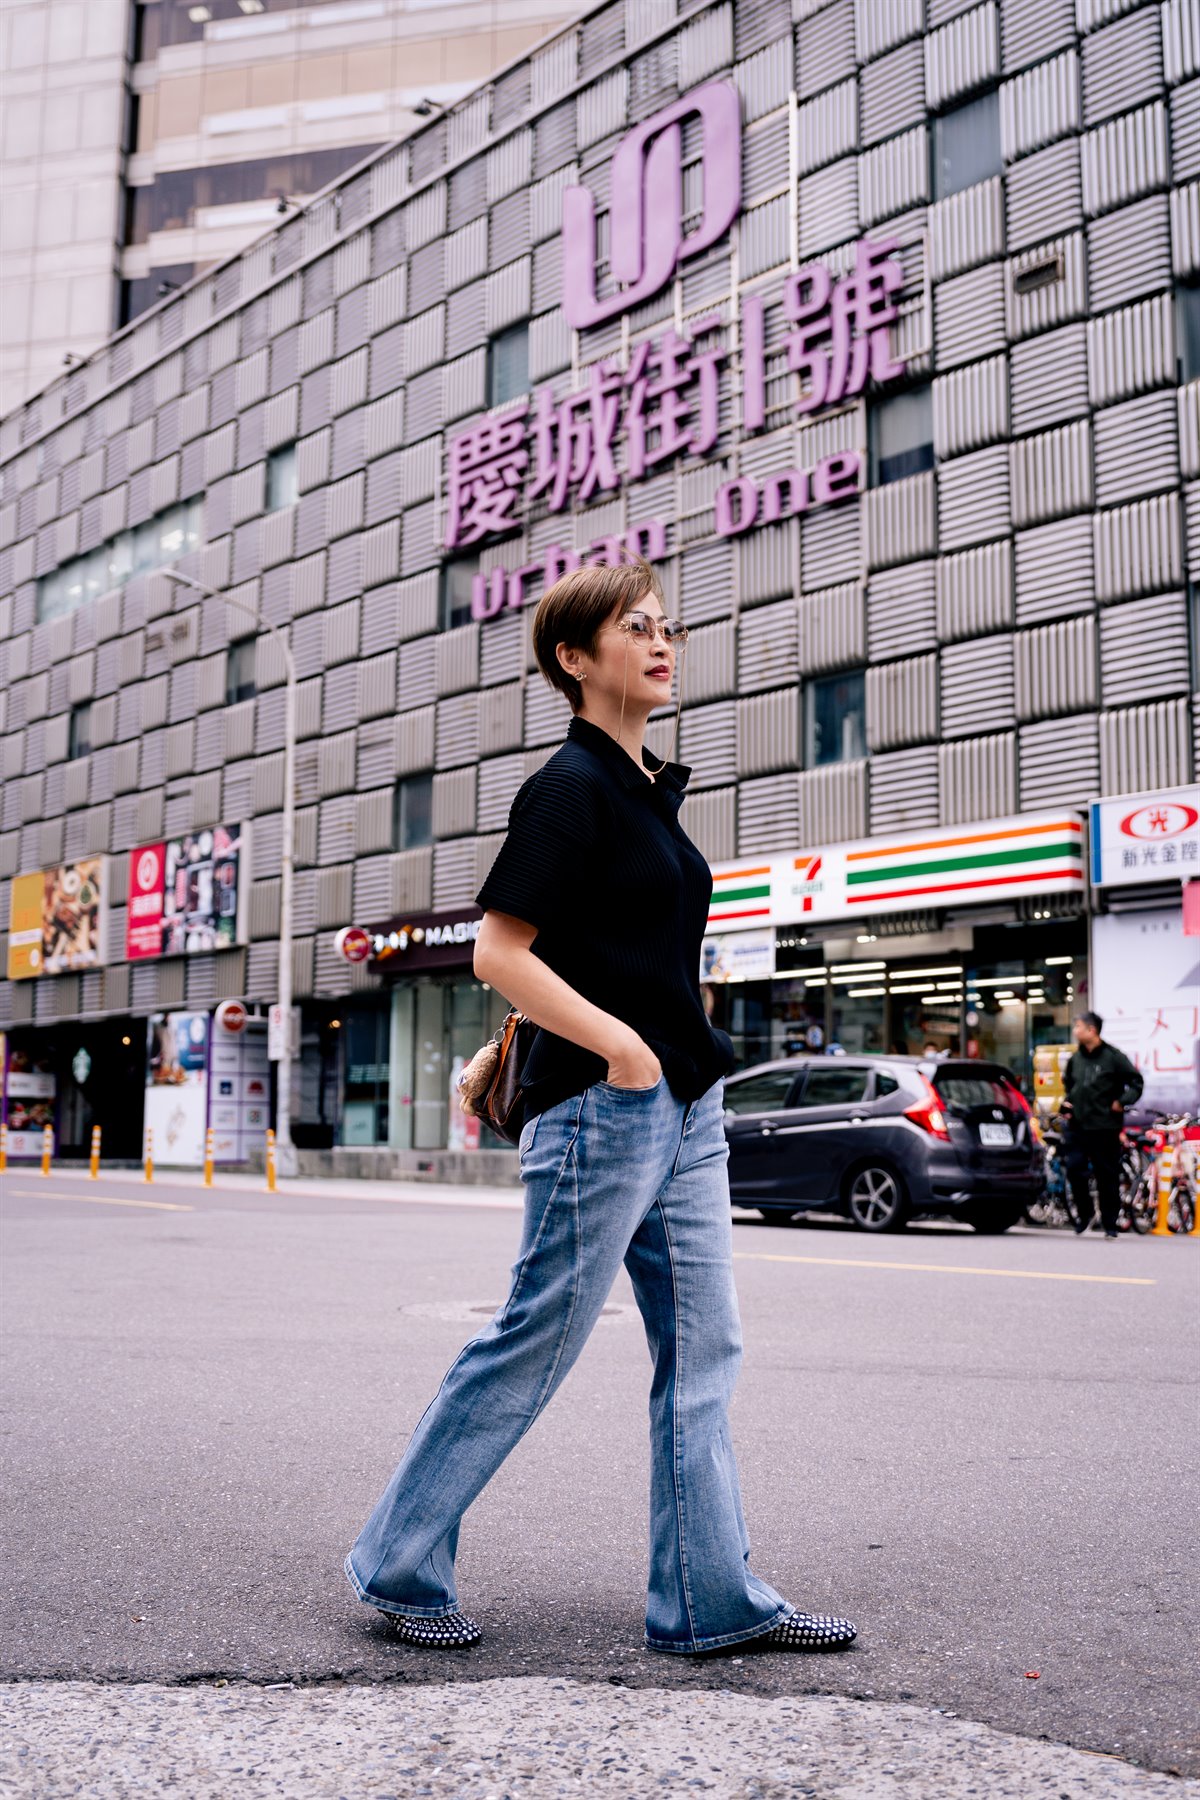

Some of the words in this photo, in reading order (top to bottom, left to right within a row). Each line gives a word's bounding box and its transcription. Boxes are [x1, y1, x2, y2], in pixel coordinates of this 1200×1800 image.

[714, 449, 862, 538] One
[1122, 840, 1198, 869] 新光金控
[794, 856, 822, 912] 7
